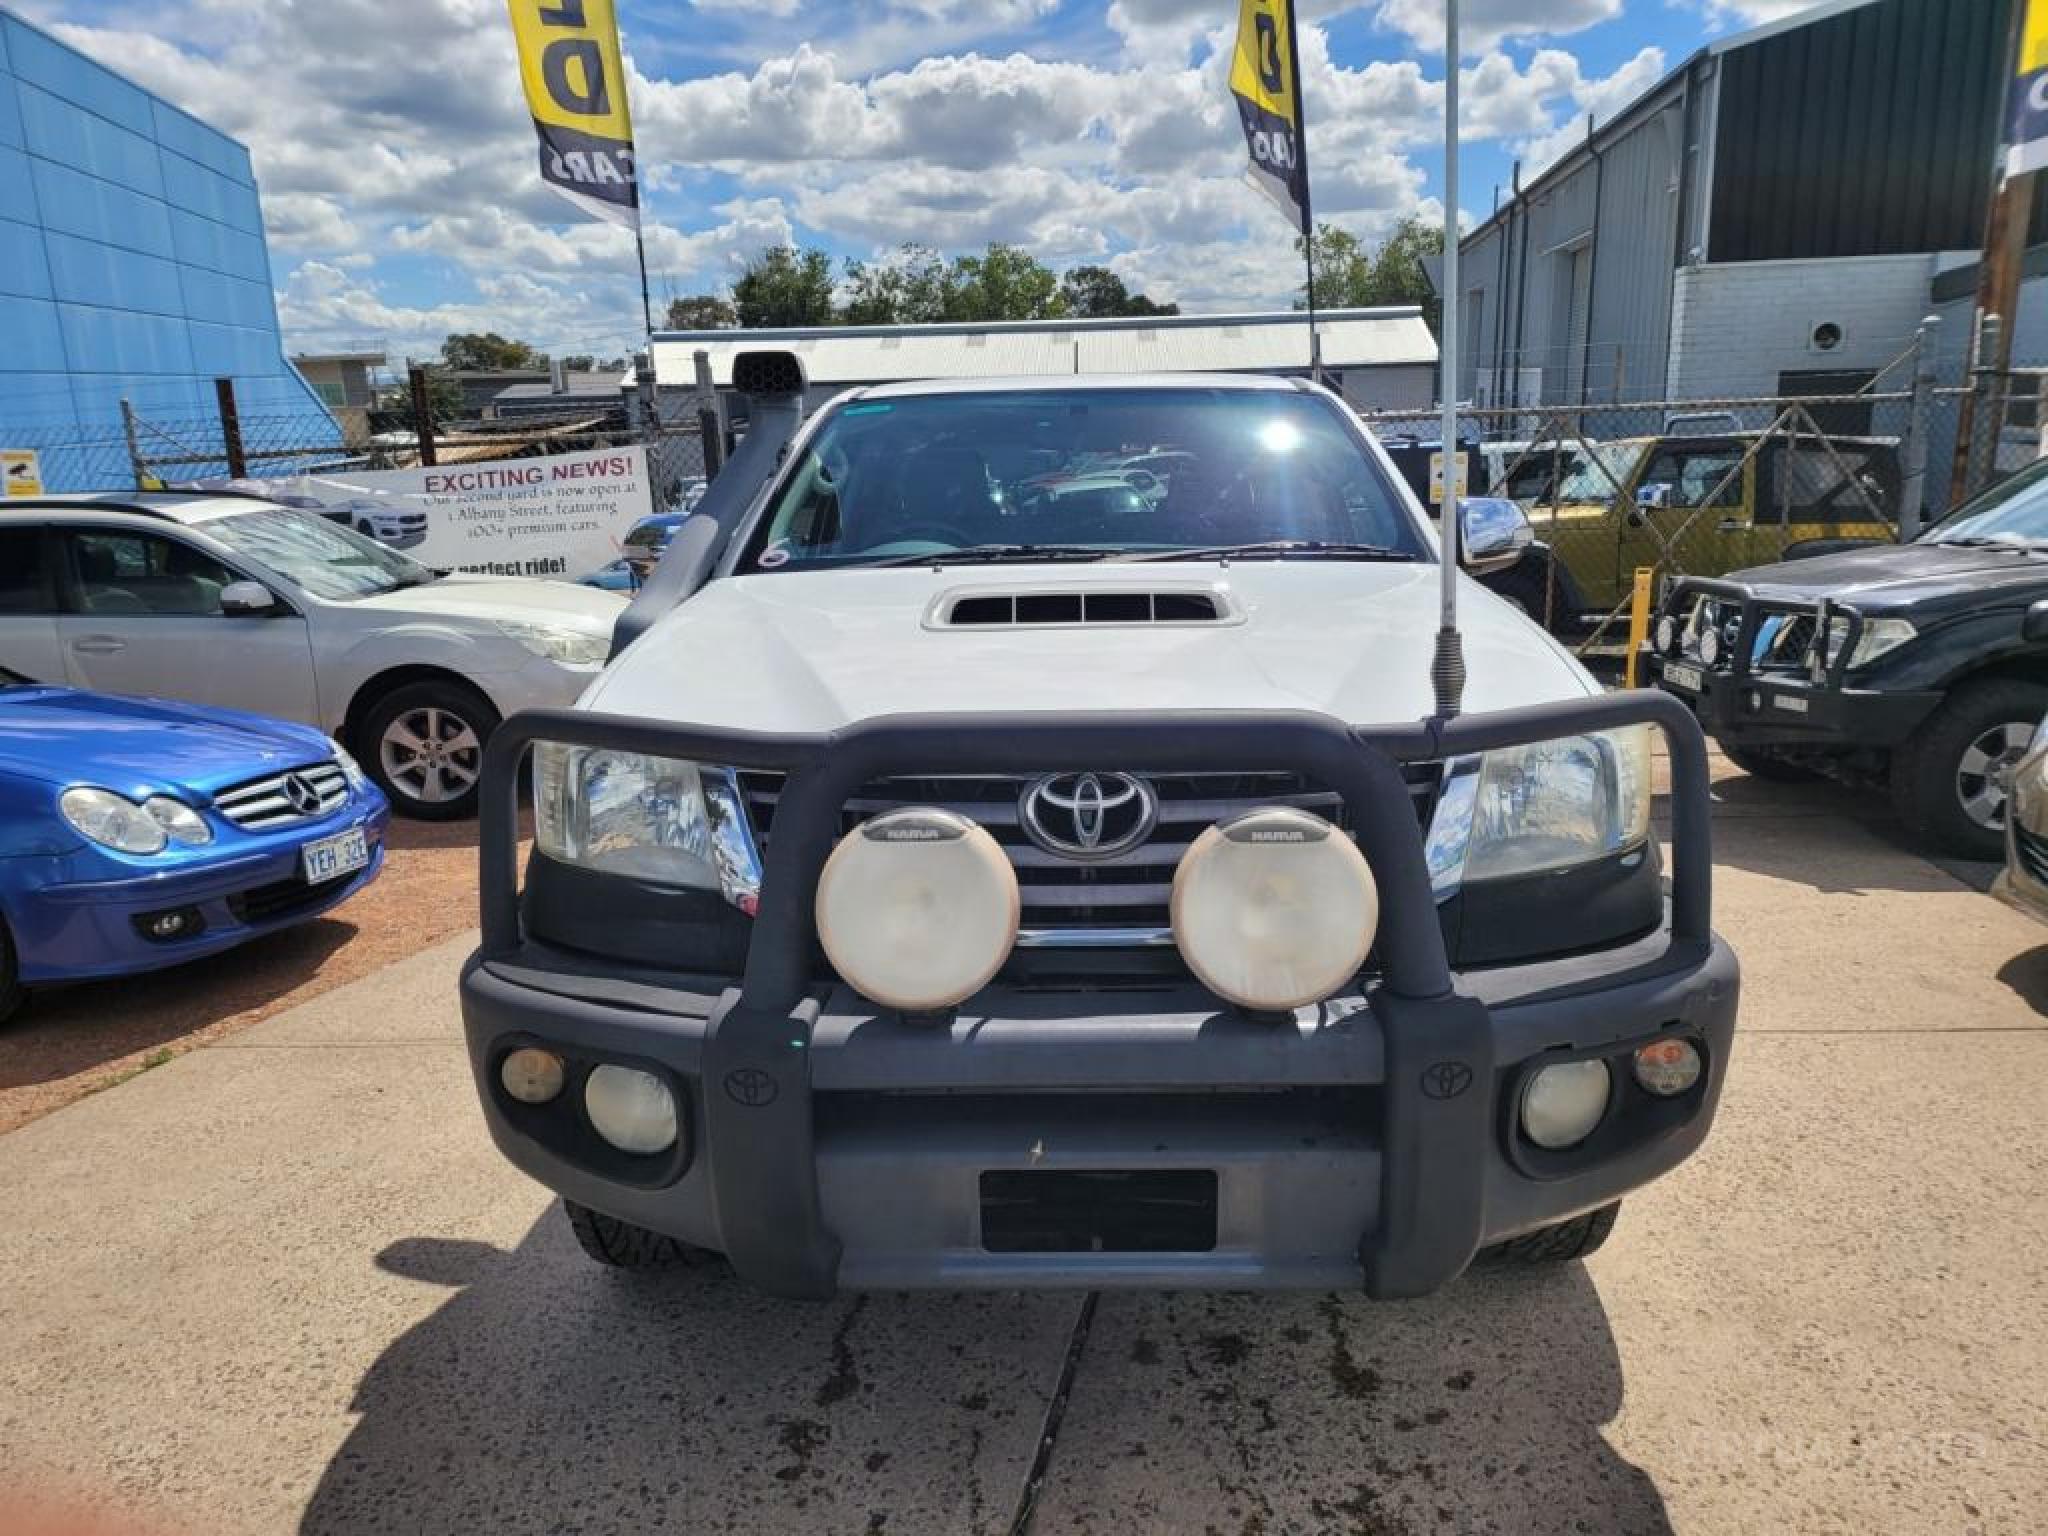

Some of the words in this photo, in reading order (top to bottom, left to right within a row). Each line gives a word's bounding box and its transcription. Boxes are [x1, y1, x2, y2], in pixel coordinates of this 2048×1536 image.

[424, 465, 543, 493] EXCITING
[552, 456, 633, 480] NEWS!
[556, 487, 585, 497] now
[588, 484, 620, 499] open
[623, 481, 638, 493] at
[457, 505, 505, 522] Albany
[556, 500, 617, 519] featuring
[508, 523, 567, 539] premium
